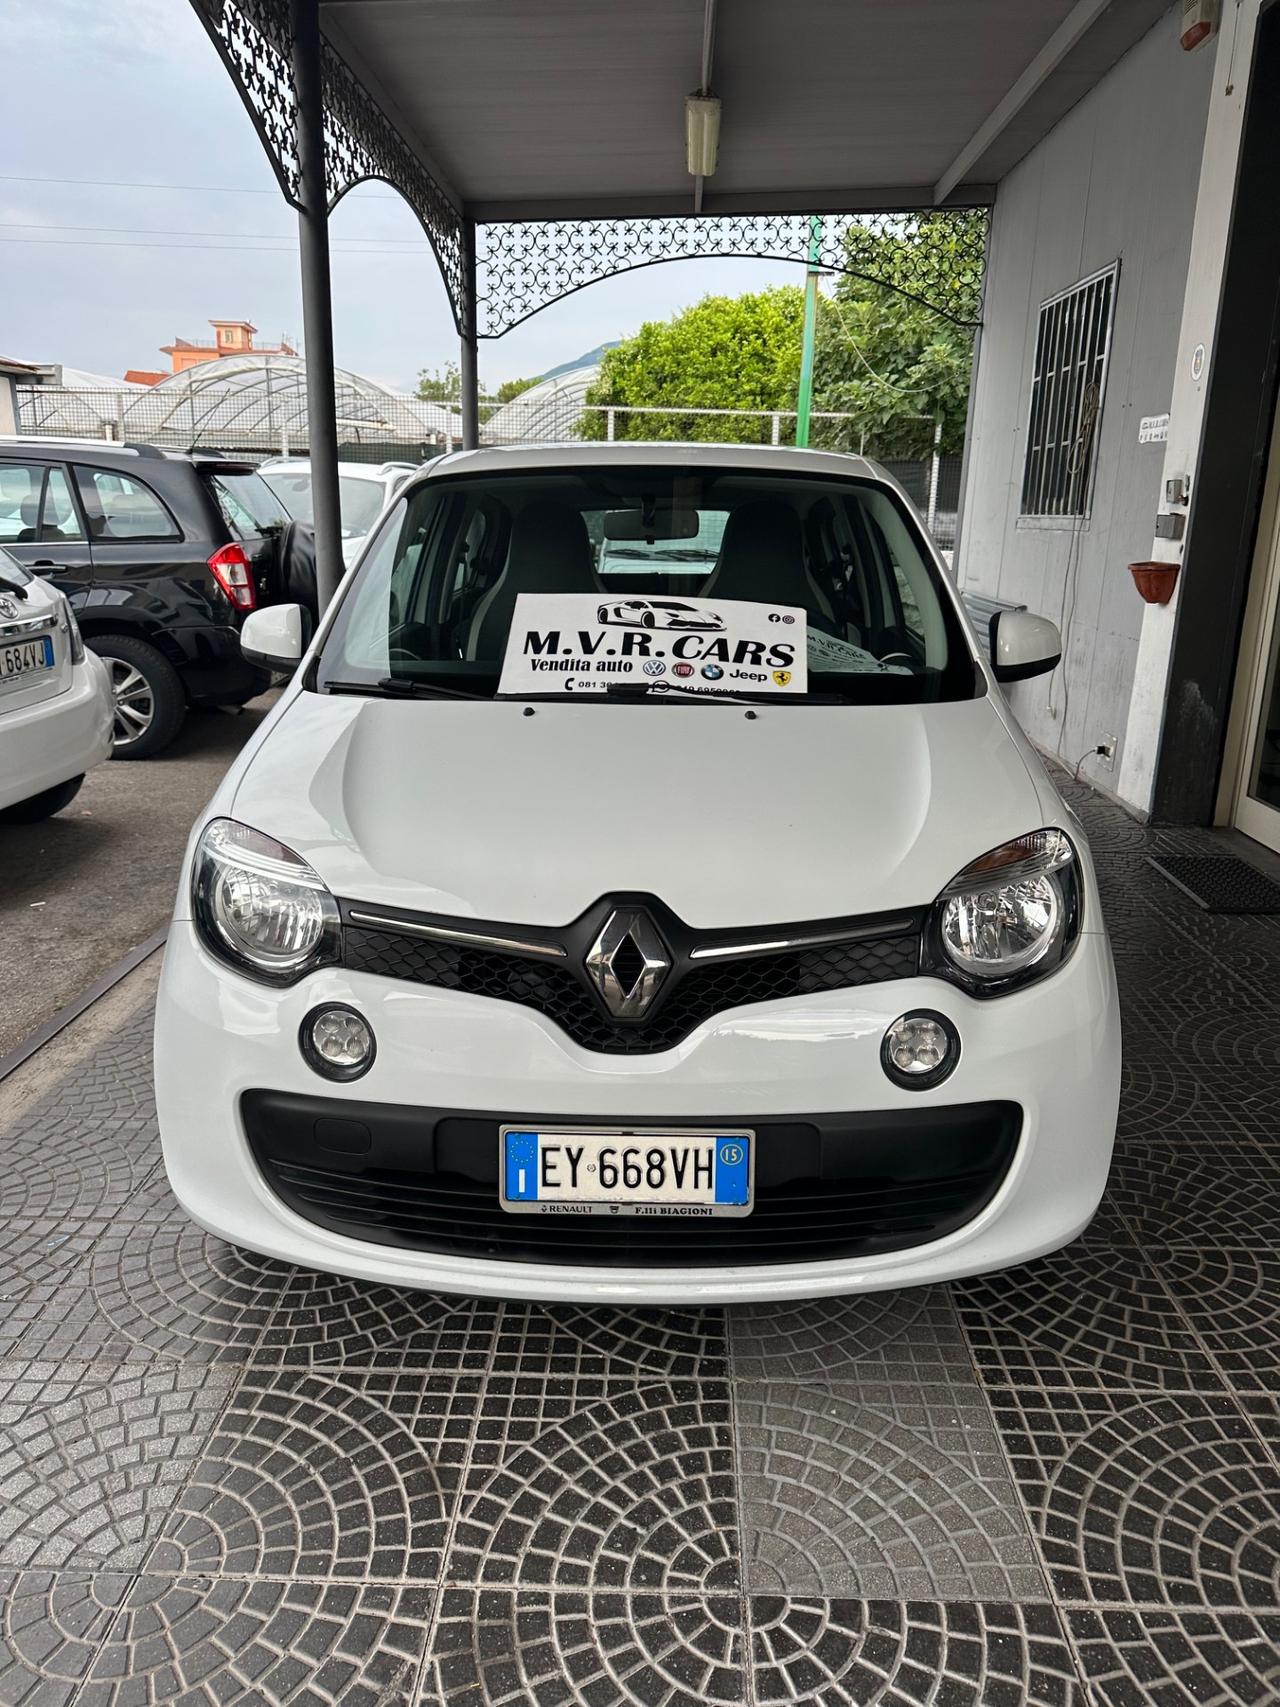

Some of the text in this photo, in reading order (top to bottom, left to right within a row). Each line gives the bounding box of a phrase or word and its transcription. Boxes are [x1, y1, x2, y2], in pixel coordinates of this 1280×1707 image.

[531, 658, 633, 673] Vendita auto
[729, 668, 768, 682] Jeep
[550, 1205, 593, 1214] RENAULT
[659, 1207, 713, 1216] BIAGIONI
